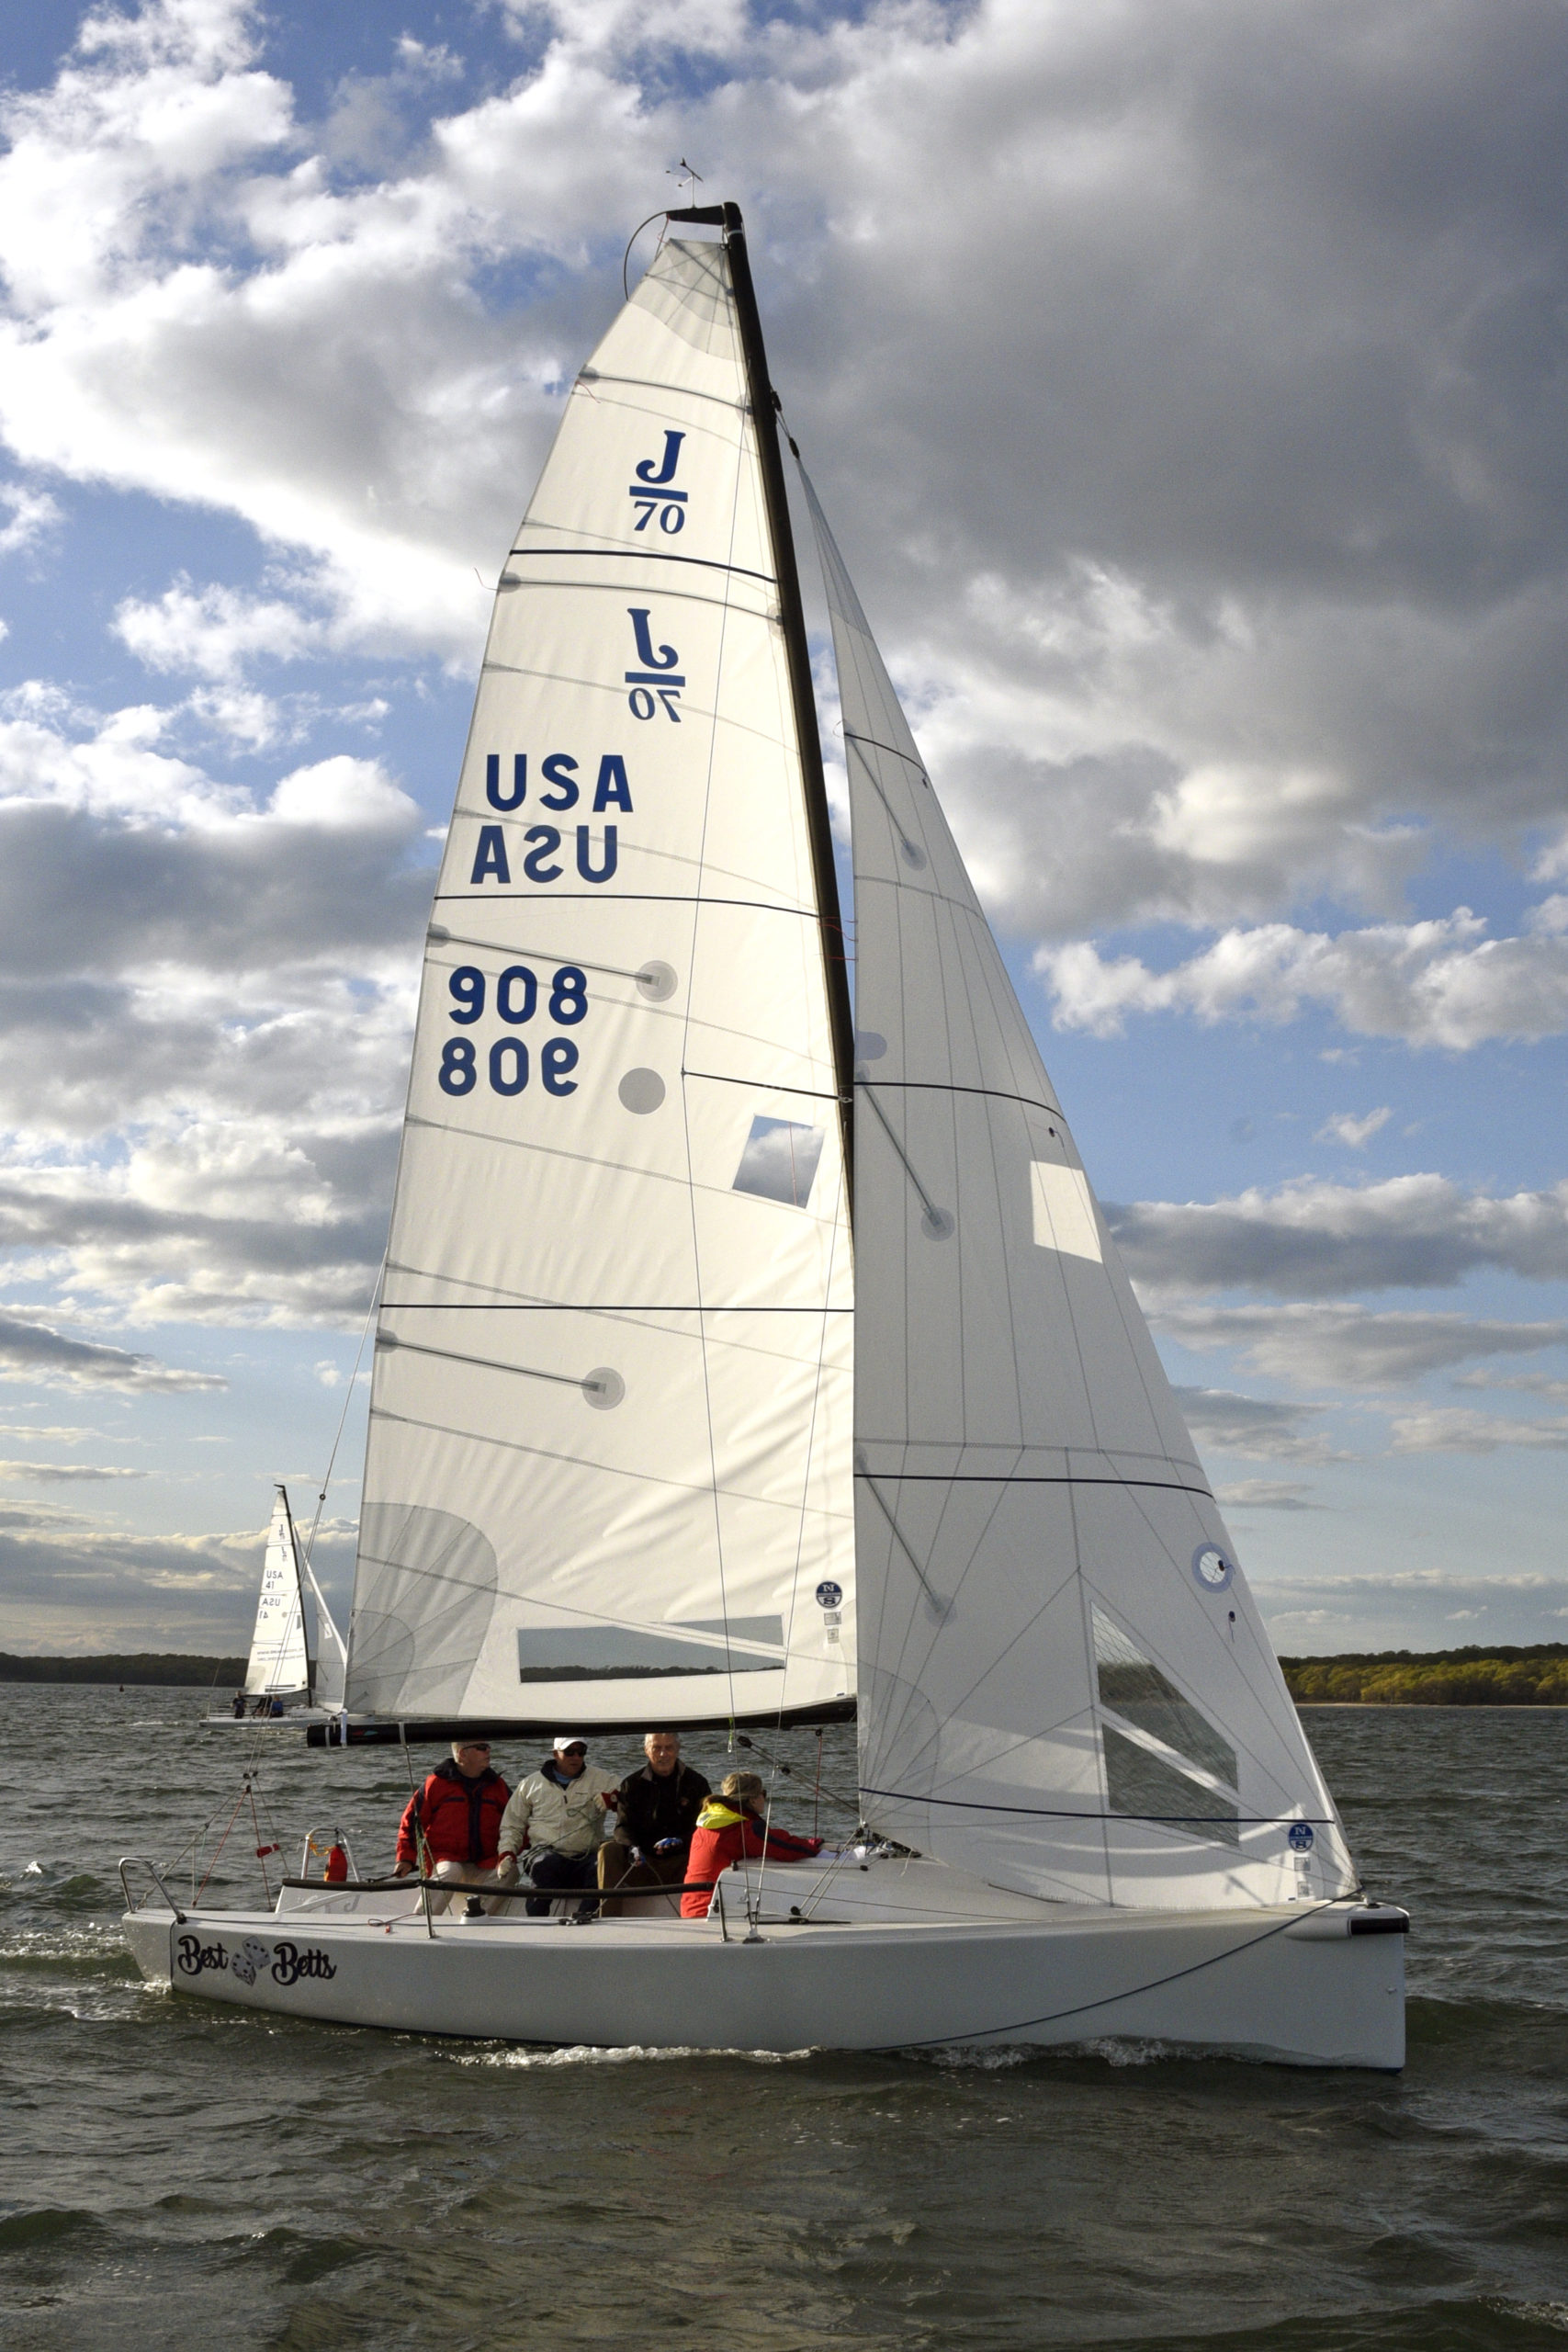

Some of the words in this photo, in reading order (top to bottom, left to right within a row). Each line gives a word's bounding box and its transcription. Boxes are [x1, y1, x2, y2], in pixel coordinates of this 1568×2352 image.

[635, 429, 686, 484] J
[634, 501, 685, 535] 70
[486, 753, 634, 813] USA
[448, 965, 588, 1026] 908
[266, 1570, 283, 1578] USA
[823, 1584, 834, 1592] N
[824, 1597, 835, 1605] S
[1295, 1826, 1305, 1835] N
[1295, 1840, 1306, 1849] S
[177, 1934, 229, 1975] Best
[271, 1941, 338, 1986] Betts
